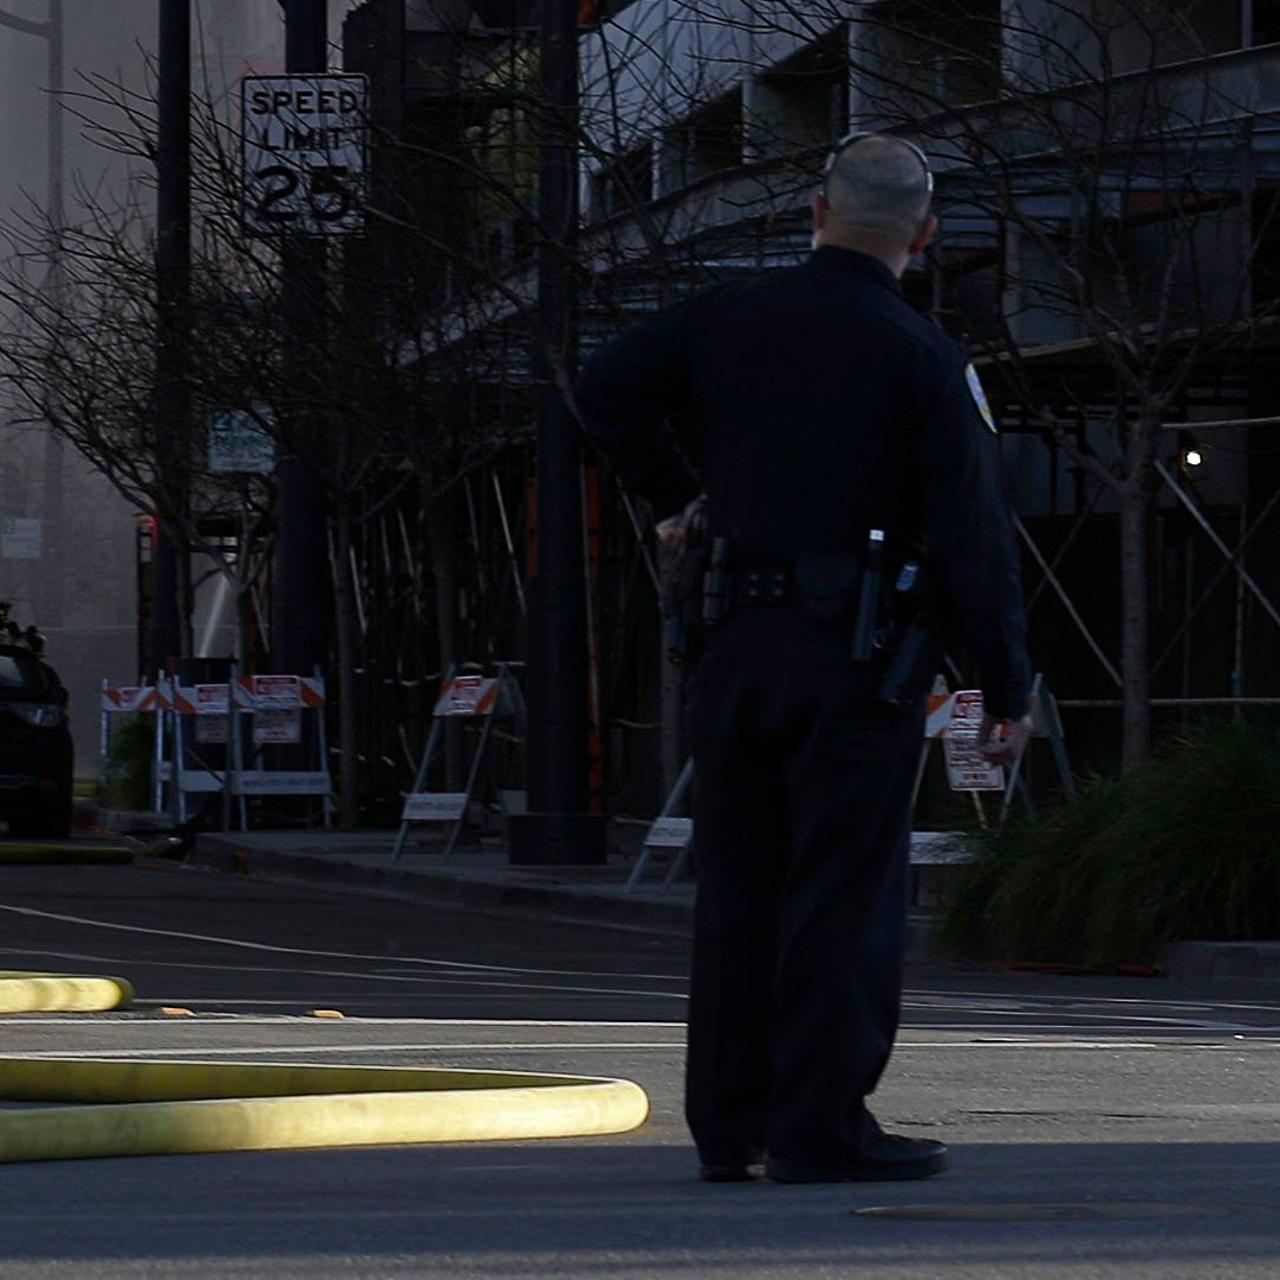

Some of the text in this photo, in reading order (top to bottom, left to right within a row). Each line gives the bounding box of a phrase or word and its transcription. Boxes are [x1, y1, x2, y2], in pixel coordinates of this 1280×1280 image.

[252, 91, 357, 115] SPEED
[263, 126, 342, 151] LIMIT
[254, 165, 348, 222] 25
